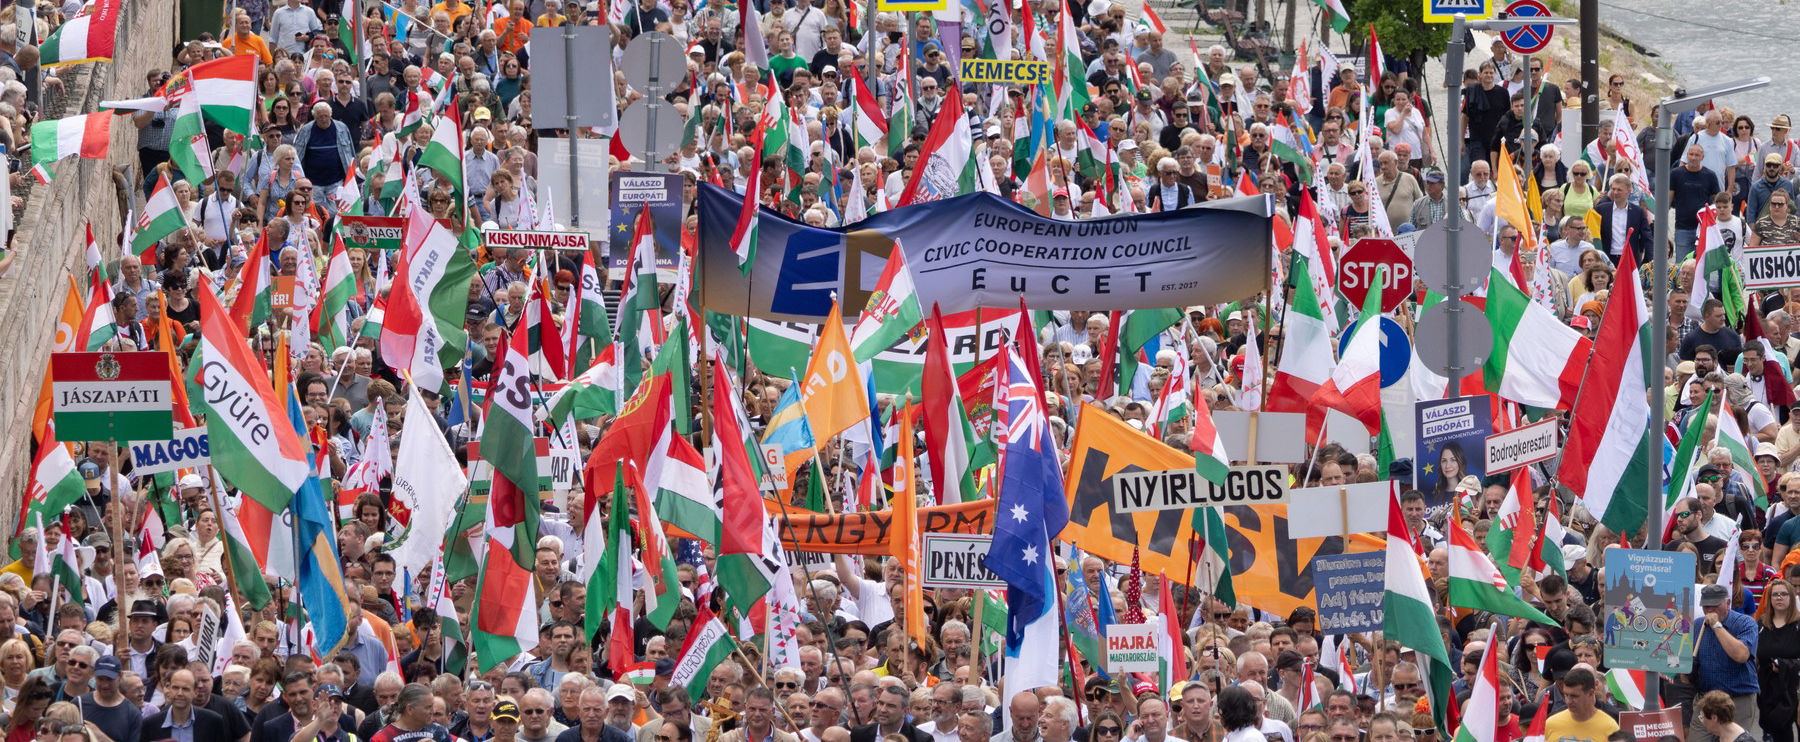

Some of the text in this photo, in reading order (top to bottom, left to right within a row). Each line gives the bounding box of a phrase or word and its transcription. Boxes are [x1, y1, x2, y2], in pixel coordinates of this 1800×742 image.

[961, 62, 1048, 81] KEMECSE
[623, 179, 662, 187] VÁLASZD
[974, 212, 1138, 237] EUROPEAN UNION
[488, 232, 587, 248] KISKUNMAJSA
[924, 235, 1192, 263] CIVIC COOPERATION COUNCIL
[1343, 261, 1409, 290] STOP
[1178, 281, 1198, 290] 2017
[61, 387, 159, 407] JÁSZAPÁTI
[203, 361, 270, 446] Gyüre
[1425, 405, 1467, 420] VÁLASZD
[1426, 419, 1471, 435] EURÓPÁT!
[1490, 431, 1553, 463] Bodrogkeresztúr
[1628, 553, 1674, 564] Vigyázzunk
[1630, 564, 1672, 573] egymásra!
[1109, 650, 1157, 662] MAGYARORSZÁG!
